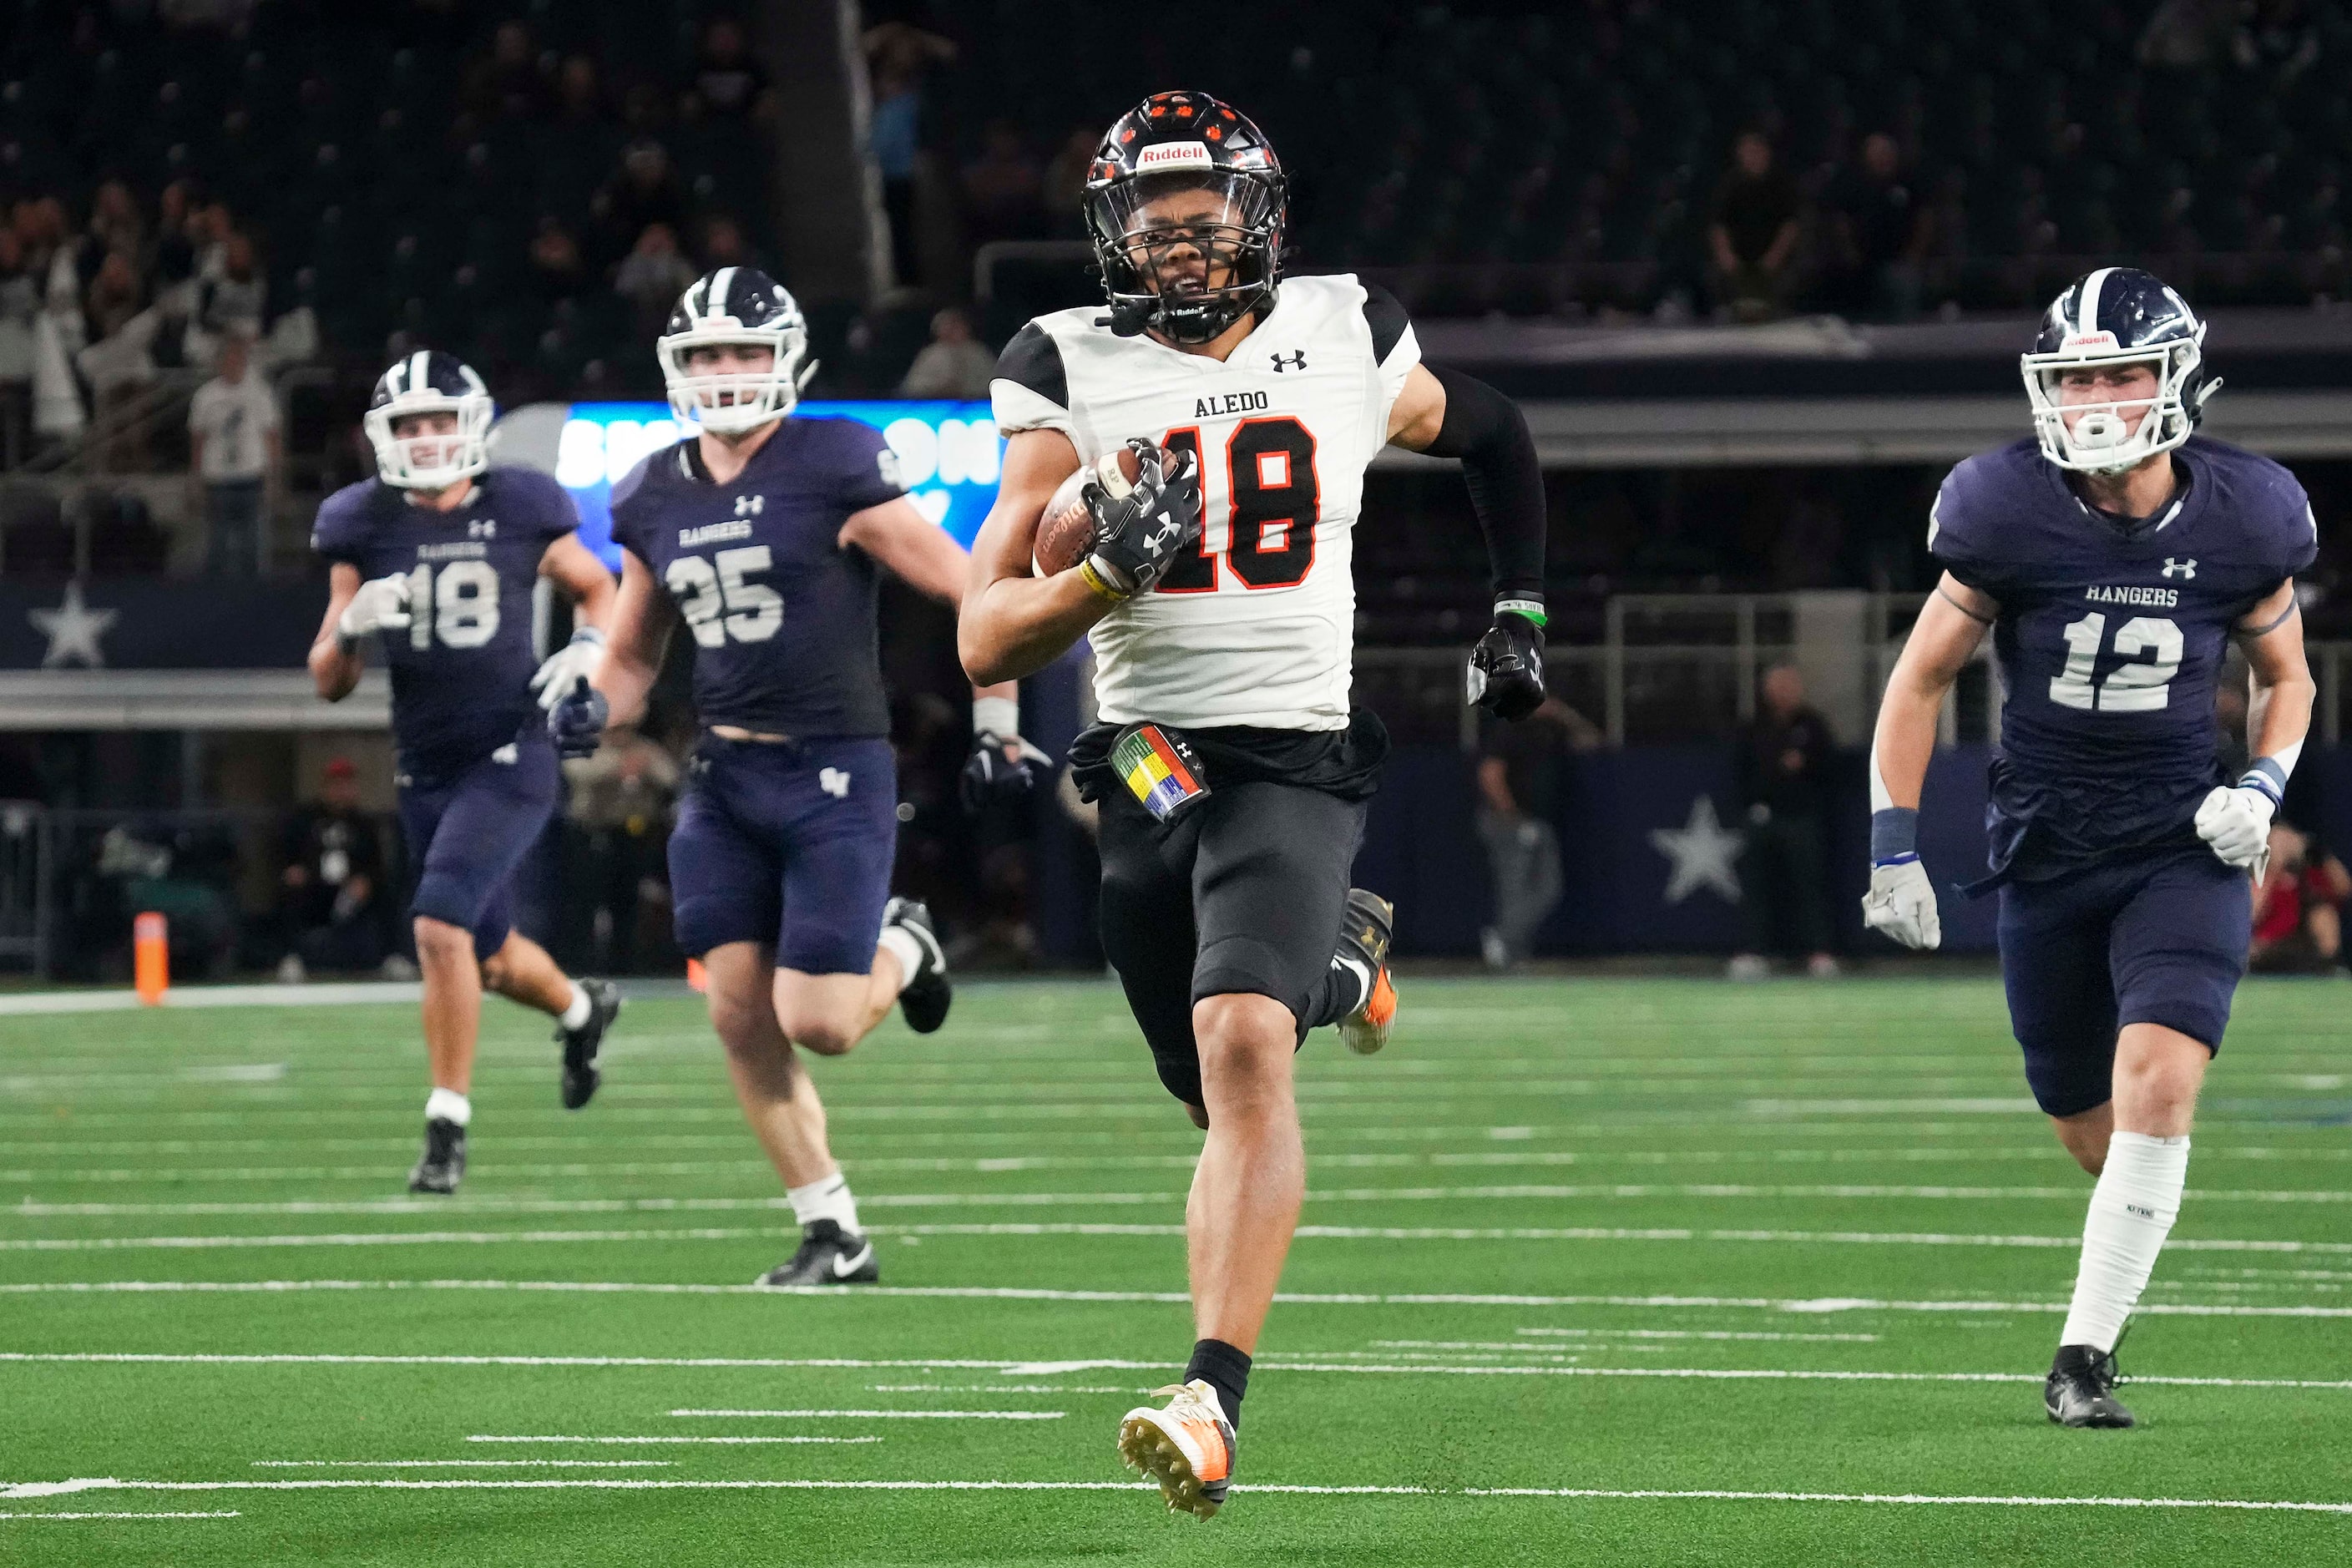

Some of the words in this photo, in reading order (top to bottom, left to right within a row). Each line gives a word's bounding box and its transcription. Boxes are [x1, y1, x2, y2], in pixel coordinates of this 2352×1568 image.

[1144, 147, 1203, 163] Riddell
[1195, 391, 1268, 417] ALEDO
[1044, 496, 1089, 553] Wilson
[1155, 415, 1321, 594] 18
[678, 519, 752, 549] RANGERS
[409, 561, 501, 651] 18
[665, 545, 784, 648] 25
[2086, 585, 2179, 608] RANGERS
[2050, 611, 2184, 712] 12
